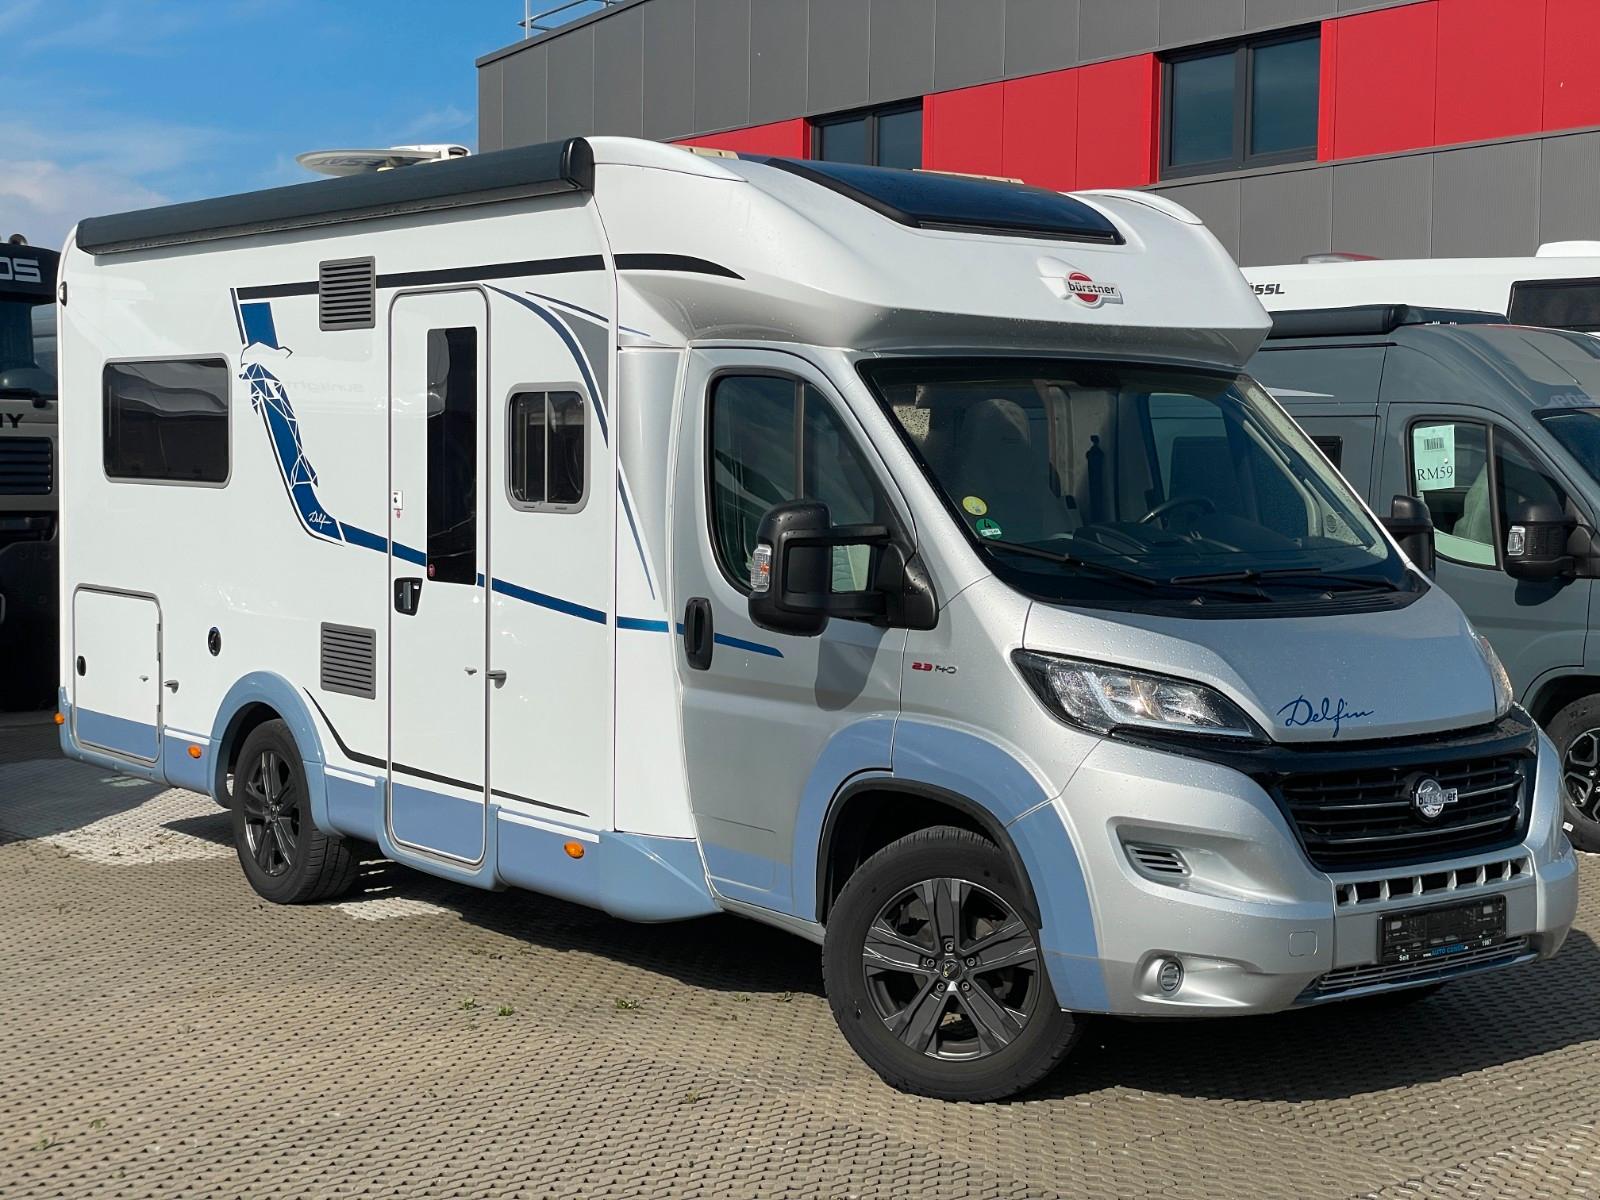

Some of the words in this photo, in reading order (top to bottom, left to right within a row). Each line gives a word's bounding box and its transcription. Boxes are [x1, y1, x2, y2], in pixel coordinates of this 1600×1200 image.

[1067, 281, 1116, 294] bürstner
[1249, 283, 1285, 295] SSL
[1417, 465, 1453, 481] RM59
[983, 519, 992, 529] 4
[1276, 695, 1374, 738] Delfin
